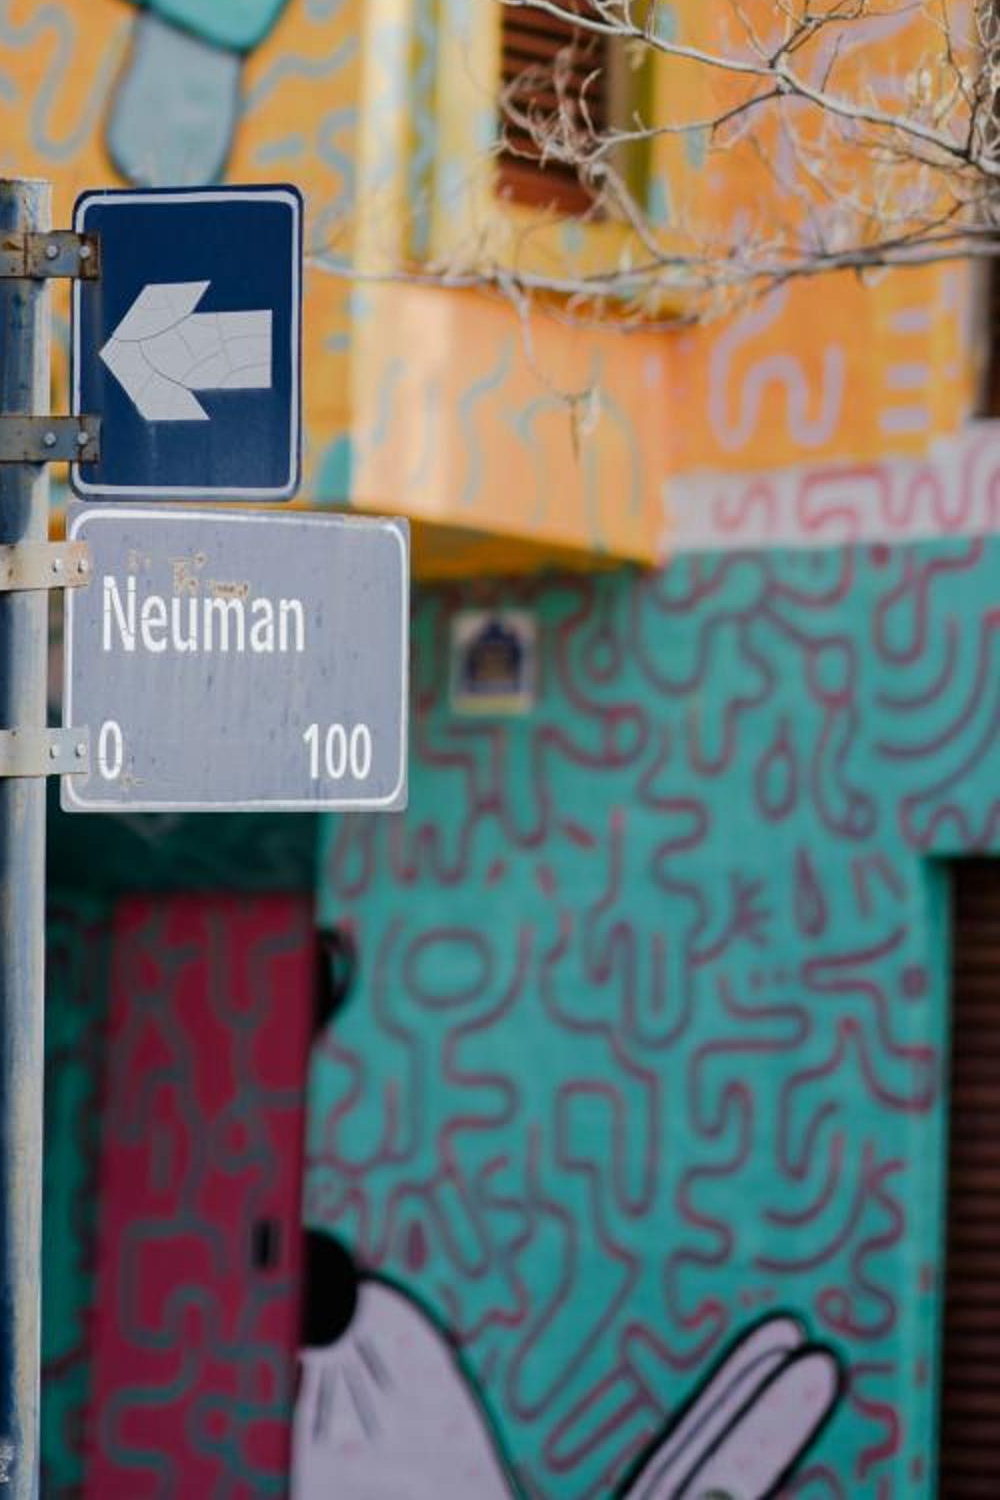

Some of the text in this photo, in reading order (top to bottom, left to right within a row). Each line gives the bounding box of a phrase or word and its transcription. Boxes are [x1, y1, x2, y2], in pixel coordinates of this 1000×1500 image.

[102, 575, 305, 652] Neuman
[99, 720, 372, 780] 0 100
